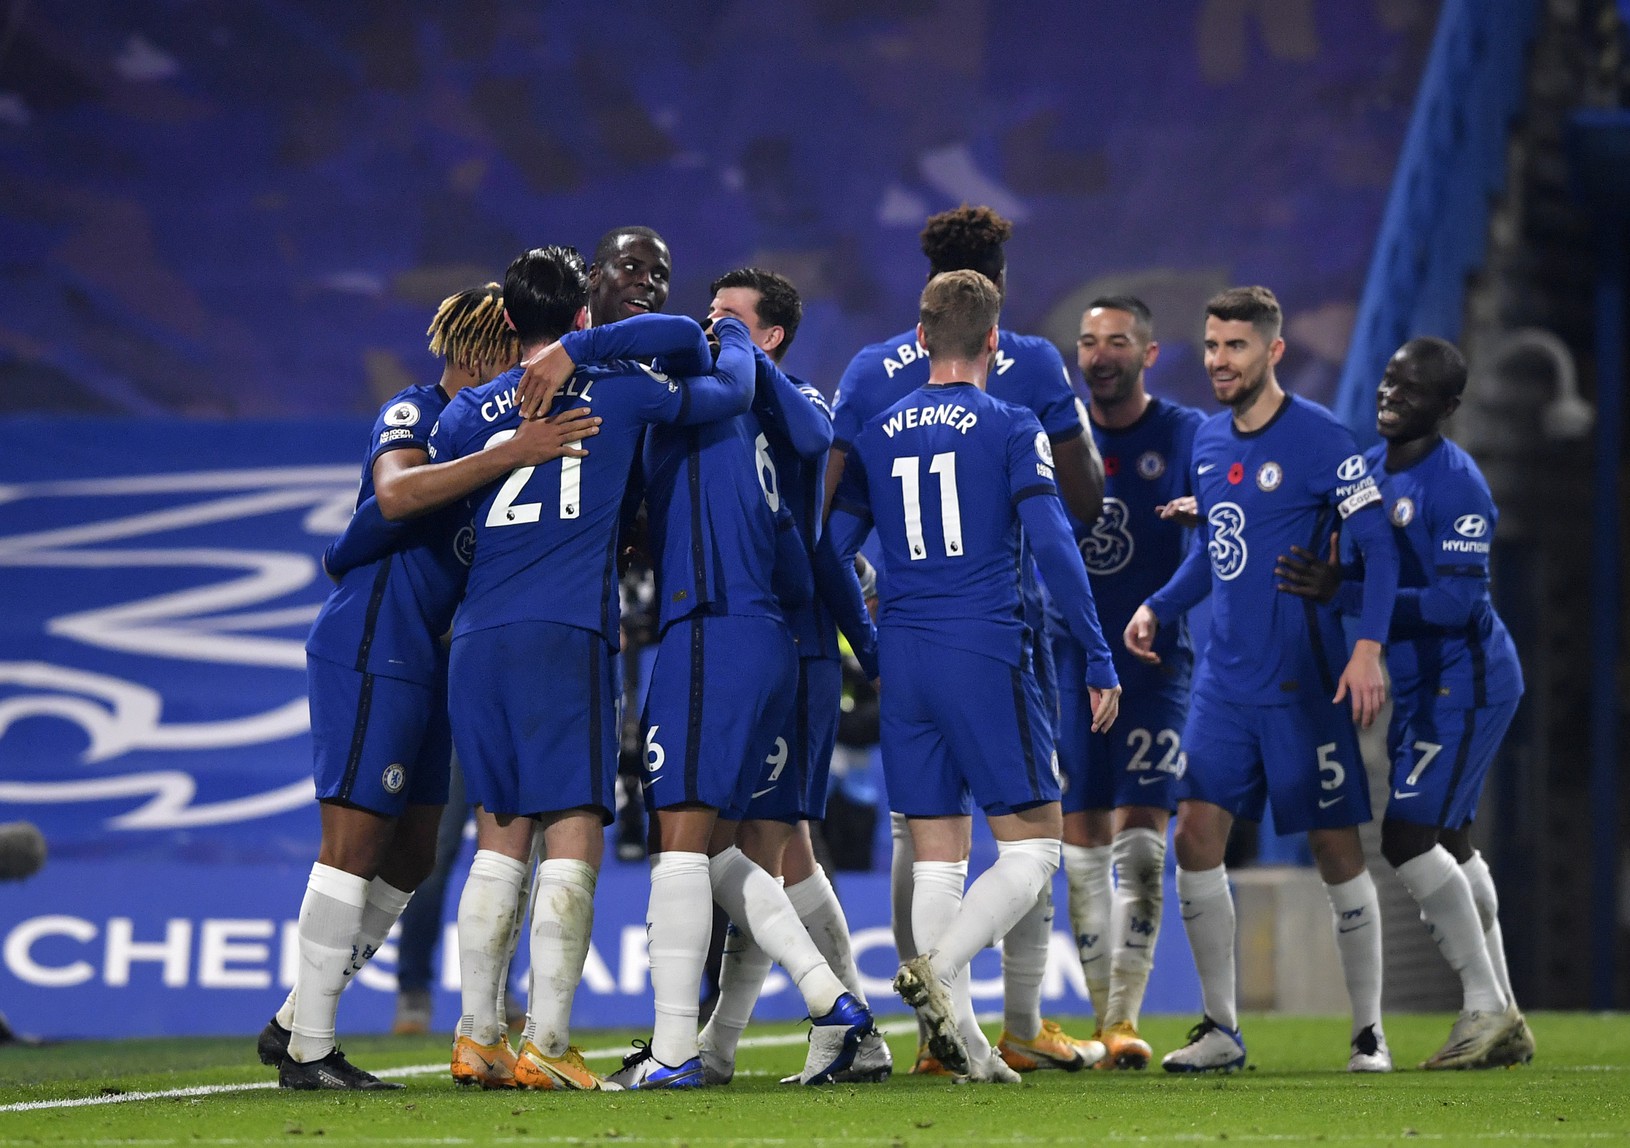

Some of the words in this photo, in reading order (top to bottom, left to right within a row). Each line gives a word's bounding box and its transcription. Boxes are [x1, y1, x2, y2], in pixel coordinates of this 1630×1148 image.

[882, 404, 977, 438] WERNER
[483, 429, 582, 528] 21
[754, 431, 780, 513] 6
[891, 451, 964, 561] 11
[643, 725, 665, 772] 6
[1126, 728, 1180, 774] 22
[1316, 742, 1346, 790] 5
[1405, 740, 1443, 786] 7
